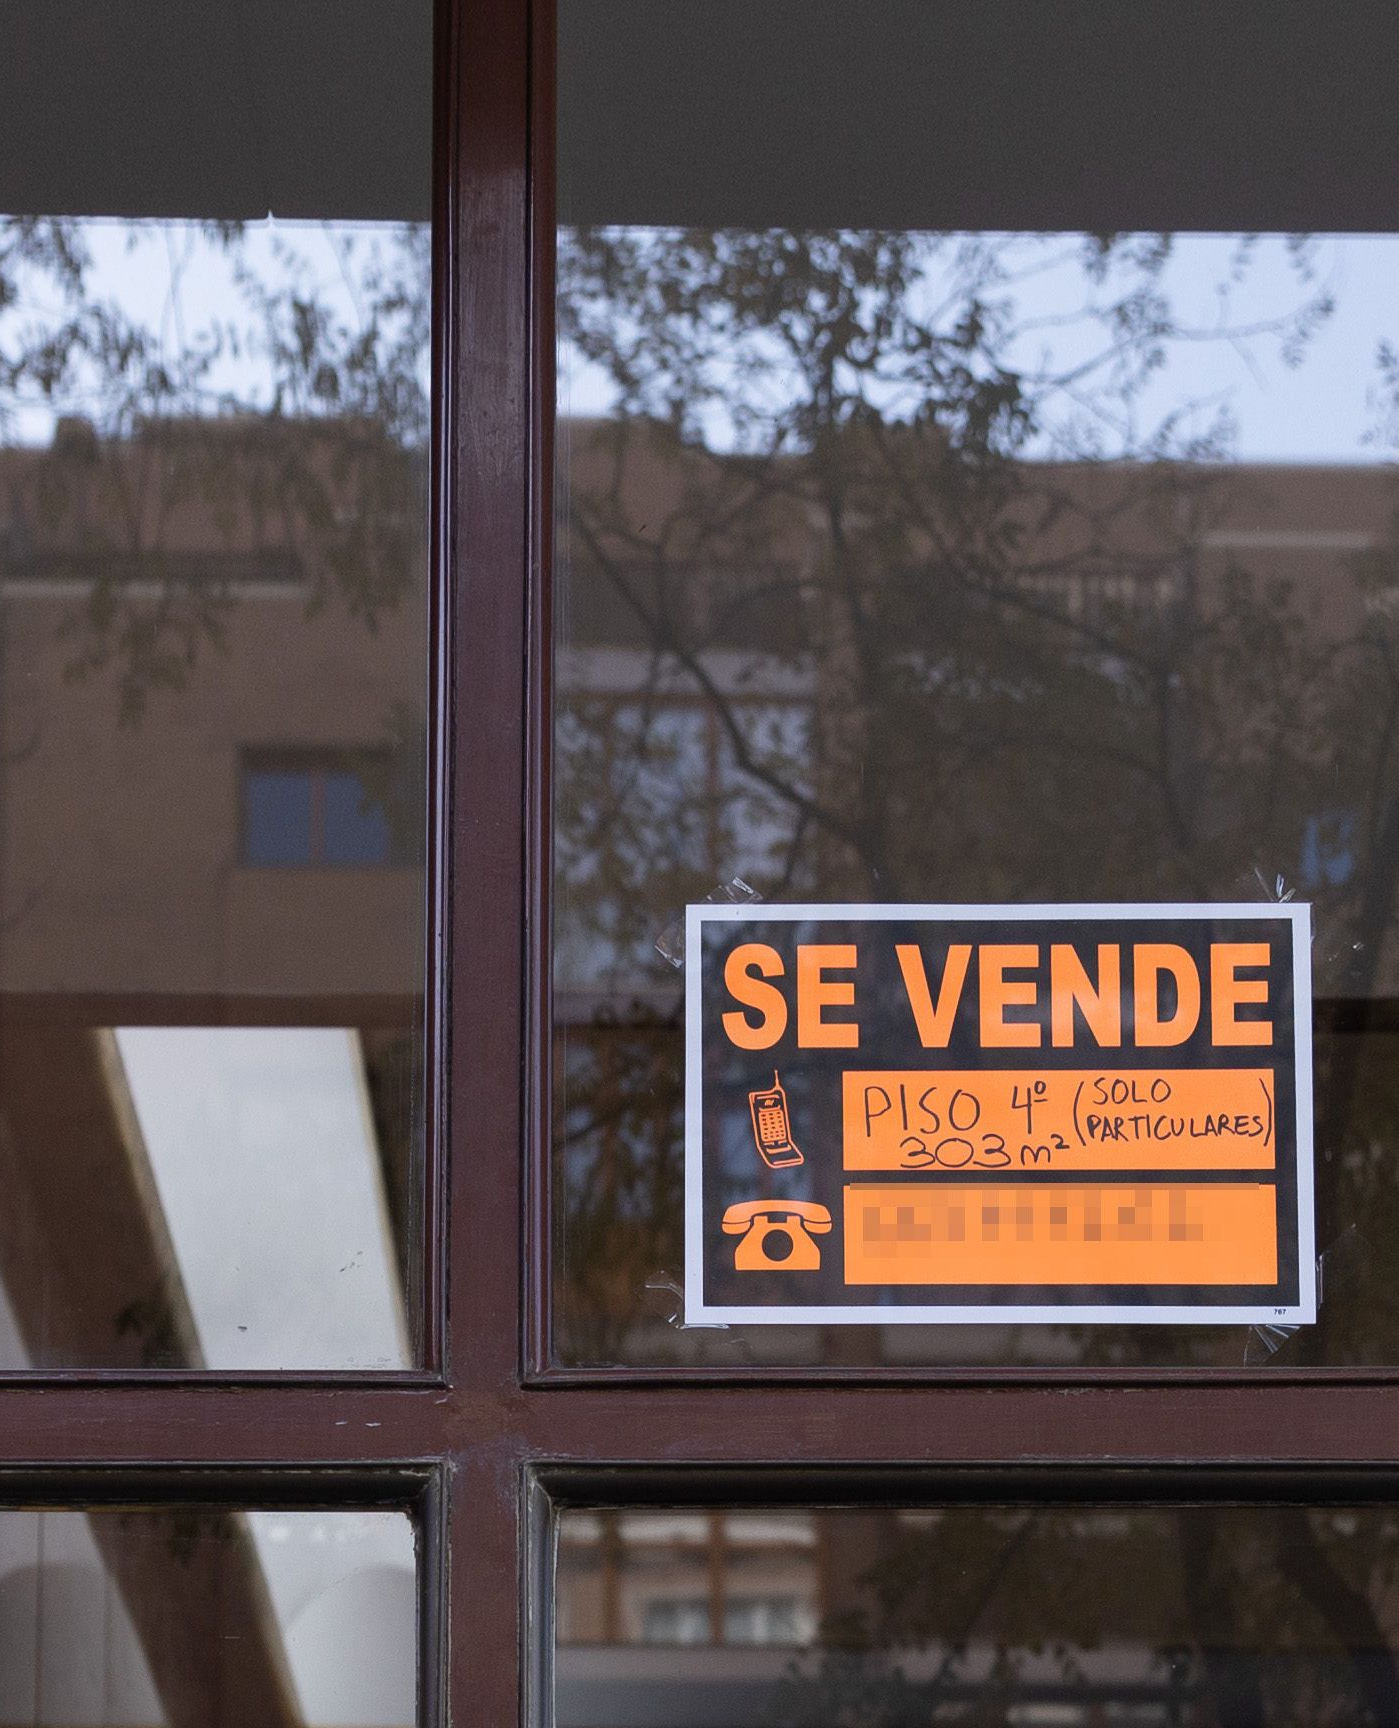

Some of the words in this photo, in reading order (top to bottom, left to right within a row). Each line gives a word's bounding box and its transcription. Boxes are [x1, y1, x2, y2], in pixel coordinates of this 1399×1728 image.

[722, 943, 859, 1050] SE
[895, 943, 1273, 1048] VENDE
[864, 1083, 981, 1137] PISO
[899, 1133, 1012, 1168] 303
